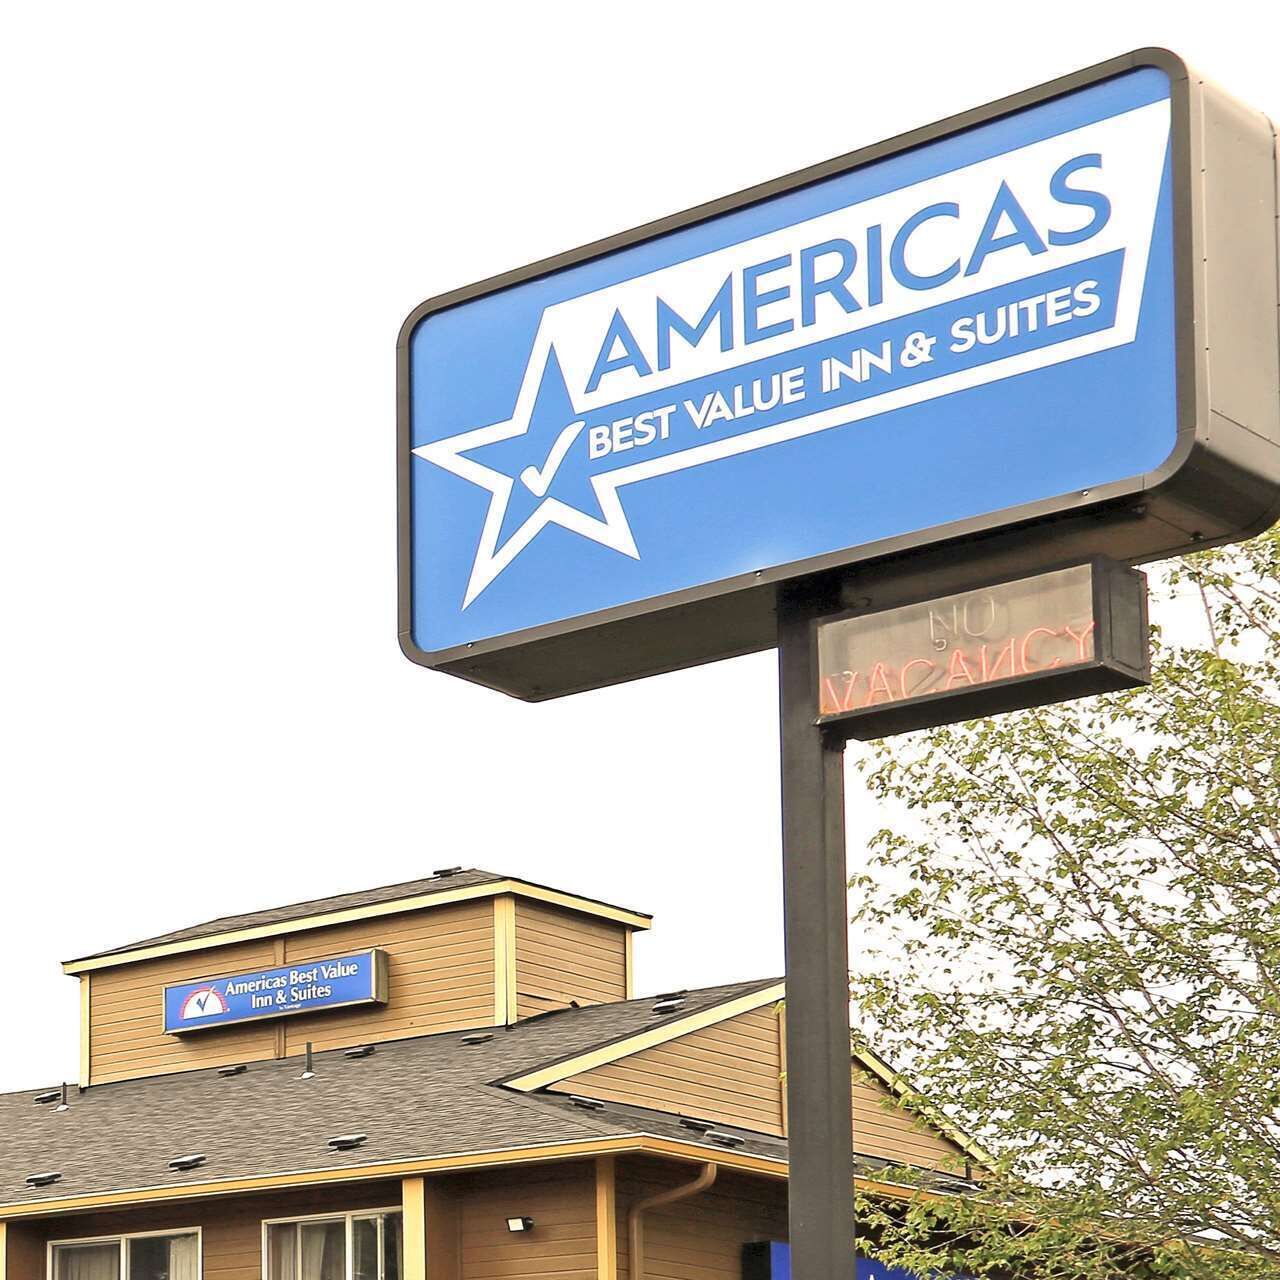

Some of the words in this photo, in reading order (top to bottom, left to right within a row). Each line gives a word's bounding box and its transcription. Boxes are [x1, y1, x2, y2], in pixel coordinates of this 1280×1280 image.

[585, 152, 1113, 395] AMERICAS
[589, 404, 678, 461] BEST
[684, 366, 807, 431] VALUE
[821, 341, 892, 395] INN
[899, 331, 938, 370] &
[951, 278, 1102, 355] SUITES
[928, 594, 996, 643] NO
[824, 621, 1095, 714] VACANCY
[225, 974, 287, 996] Americas
[289, 969, 318, 986] Best
[321, 961, 359, 979] Value
[251, 994, 273, 1008] Inn
[275, 990, 287, 1004] &
[290, 983, 332, 1001] Suites
